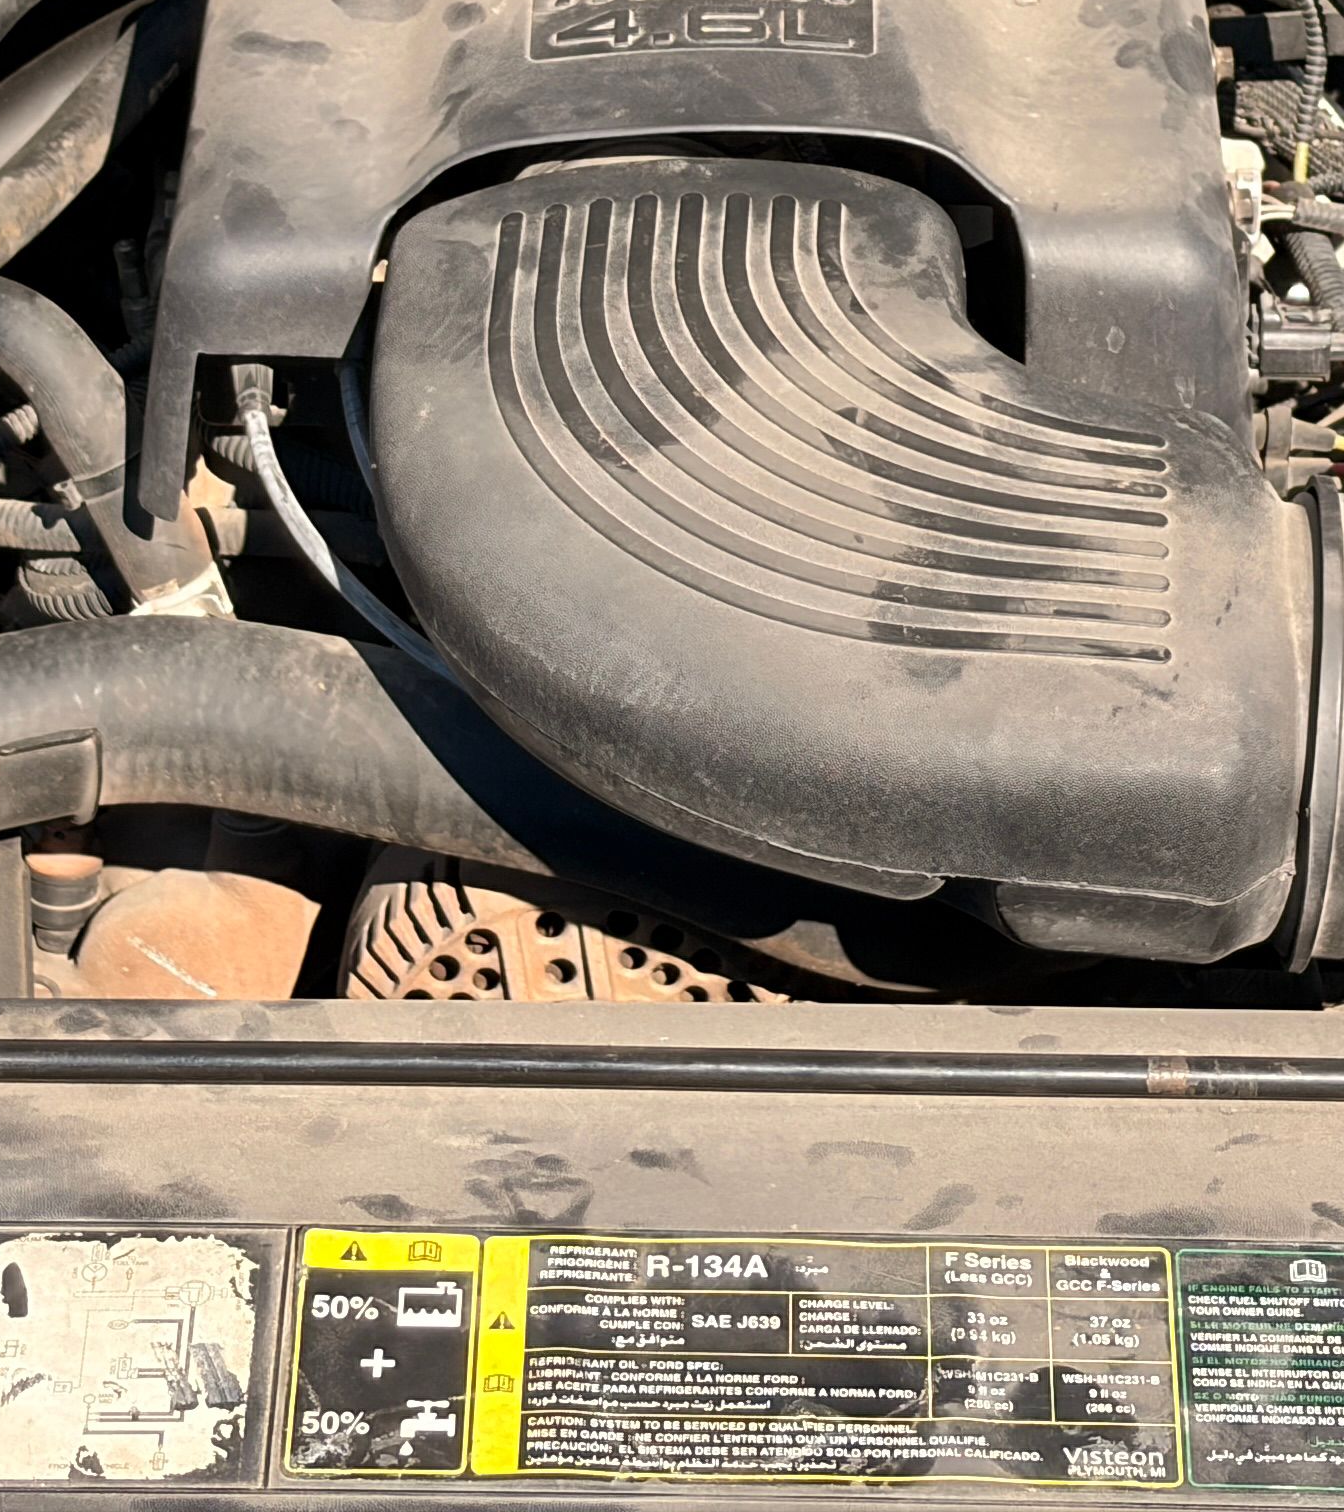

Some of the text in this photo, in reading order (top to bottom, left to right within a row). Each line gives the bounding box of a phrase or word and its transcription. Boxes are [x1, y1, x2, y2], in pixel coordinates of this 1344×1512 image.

[553, 6, 856, 48] 4.6L
[550, 1245, 638, 1258] REFRIGERANT:
[646, 1254, 769, 1278] R-134A
[945, 1251, 1032, 1270] F Series
[1064, 1254, 1150, 1268] Blackwood
[944, 1270, 1033, 1287] (Less GCC)
[1099, 1268, 1111, 1279] &
[1056, 1279, 1161, 1292] GCC F-Series
[584, 1294, 685, 1306] COMPLIES WITH:
[799, 1299, 895, 1310] CHARGE LEVEL:
[1188, 1295, 1227, 1305] CHECK
[1229, 1296, 1257, 1305] FUEL
[1259, 1297, 1310, 1307] SHUTOFF
[311, 1294, 379, 1320] 50%
[530, 1304, 599, 1316] CONFORME
[613, 1308, 631, 1317] LA
[632, 1308, 678, 1318] NORME
[1188, 1306, 1305, 1317] YOUR OWNER GUIDE.
[691, 1314, 781, 1330] SAE J639
[799, 1312, 850, 1322] CHARGE
[967, 1311, 1008, 1326] 33 oz
[1089, 1315, 1131, 1329] 37 oz
[599, 1319, 685, 1331] CUMPLE CON:
[799, 1324, 922, 1336] CARGA DE LLENADO:
[991, 1329, 1016, 1345] kg)
[1072, 1331, 1140, 1348] (1.05 kg)
[1243, 1333, 1257, 1343] LA
[1259, 1334, 1324, 1344] COMMANDE
[1326, 1336, 1342, 1345] DE
[618, 1360, 639, 1370] OIL
[649, 1361, 684, 1370] FORD
[686, 1361, 724, 1371] SPEC:
[528, 1369, 602, 1381] LUBRIFIANT
[610, 1372, 681, 1383] CONFORME
[696, 1374, 713, 1383] LA
[715, 1374, 761, 1384] NORME
[763, 1374, 799, 1385] FORD
[1062, 1373, 1160, 1385] WSH-M1C231-B
[1192, 1367, 1233, 1377] REVISE
[1235, 1368, 1250, 1377] EL
[1251, 1368, 1330, 1379] INTERRUPTOR
[527, 1381, 917, 1399] USE ACEITE PARA REFRIGERANTES CONFORME A NORMA FORD:
[990, 1387, 1006, 1396] oz
[1088, 1388, 1098, 1399] 9
[1111, 1389, 1127, 1399] oz
[994, 1400, 1014, 1412] cc)
[1115, 1404, 1136, 1415] cc)
[302, 1411, 370, 1435] 50%
[527, 1416, 586, 1427] CAUTION:
[589, 1418, 640, 1429] SYSTEM
[643, 1420, 660, 1430] TO
[663, 1421, 681, 1430] BE
[684, 1421, 745, 1431] SERVICED
[748, 1422, 765, 1431] BY
[618, 1444, 635, 1454] EL
[637, 1445, 692, 1455] SISTEMA
[695, 1445, 729, 1455] DEBE
[732, 1446, 757, 1456] SER
[825, 1448, 861, 1457] SOLO
[863, 1449, 891, 1458] POR
[893, 1449, 962, 1459] PERSONAL
[964, 1449, 1044, 1462] CALIFICADO.
[1062, 1446, 1165, 1466] Visteon
[1150, 1466, 1166, 1478] MI
